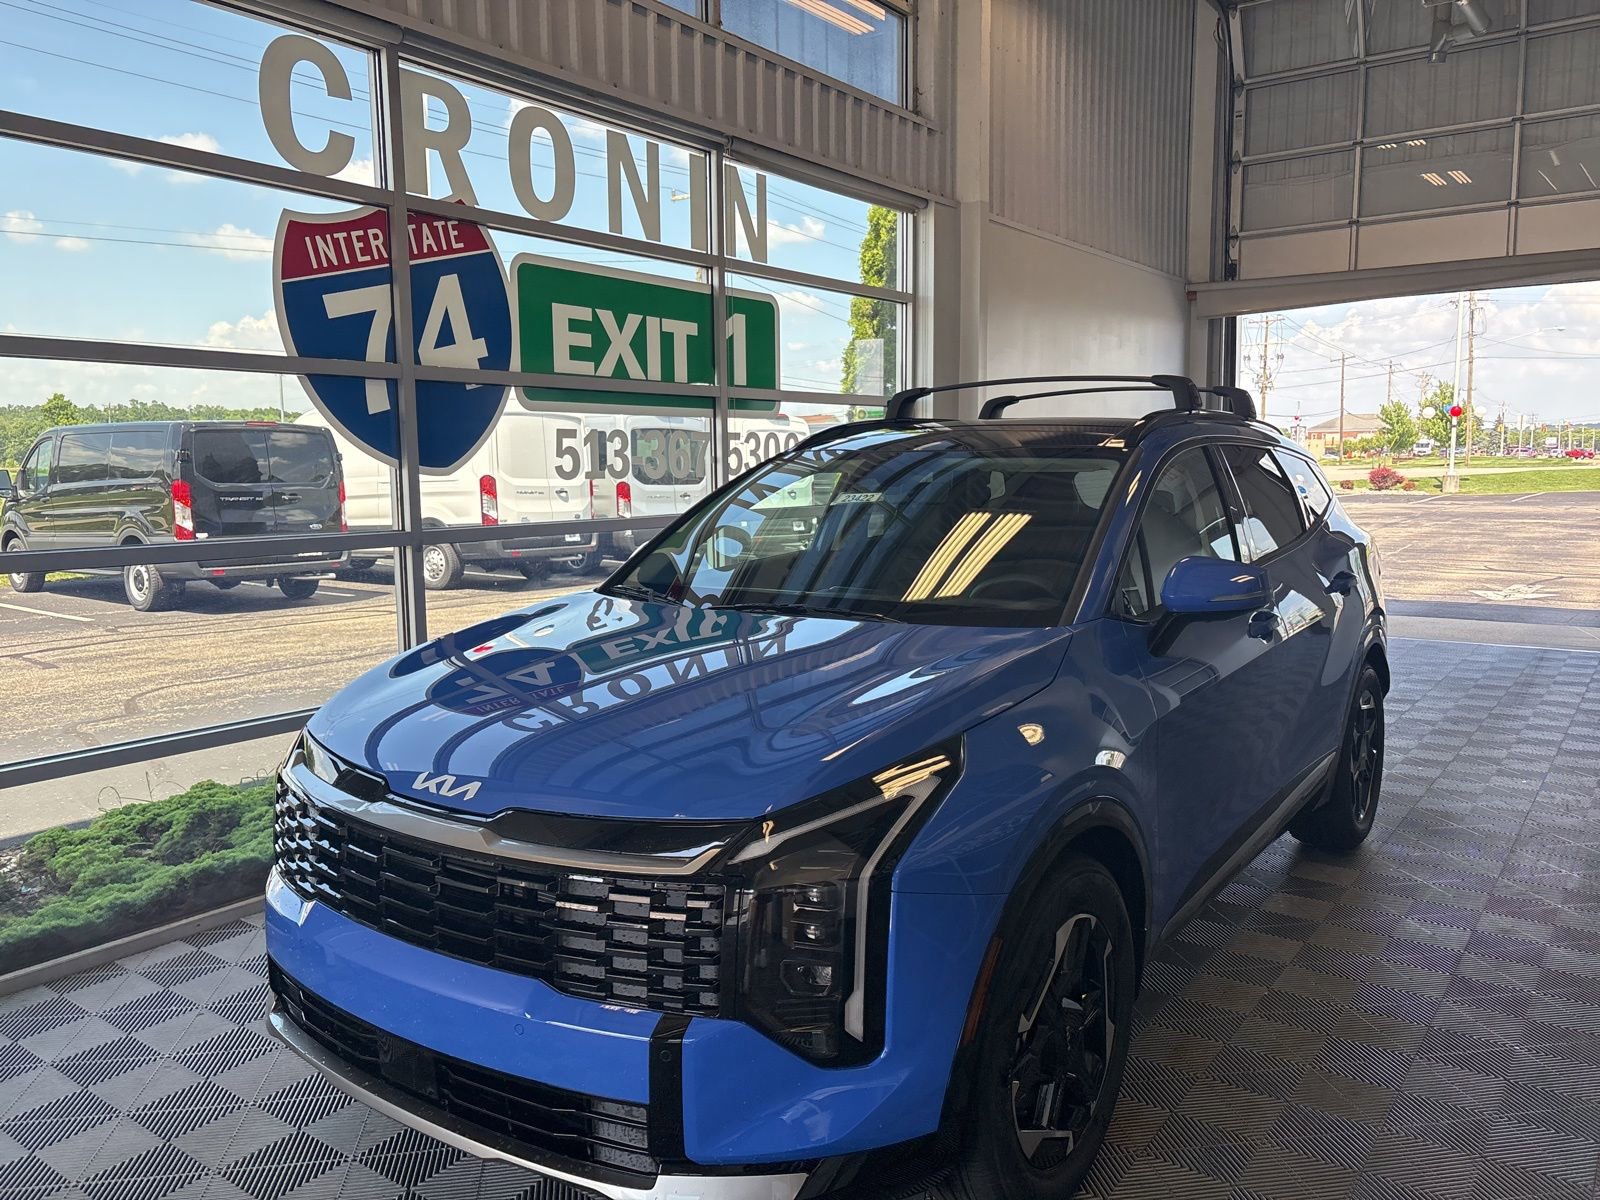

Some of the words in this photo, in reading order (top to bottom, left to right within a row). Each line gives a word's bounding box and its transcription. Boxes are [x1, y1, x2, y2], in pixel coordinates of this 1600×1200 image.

[259, 34, 767, 264] CRONIN
[304, 220, 465, 269] INTERTATE
[322, 273, 489, 415] 74
[551, 302, 699, 384] EXIT
[725, 312, 747, 386] 1
[411, 771, 482, 801] KIA
